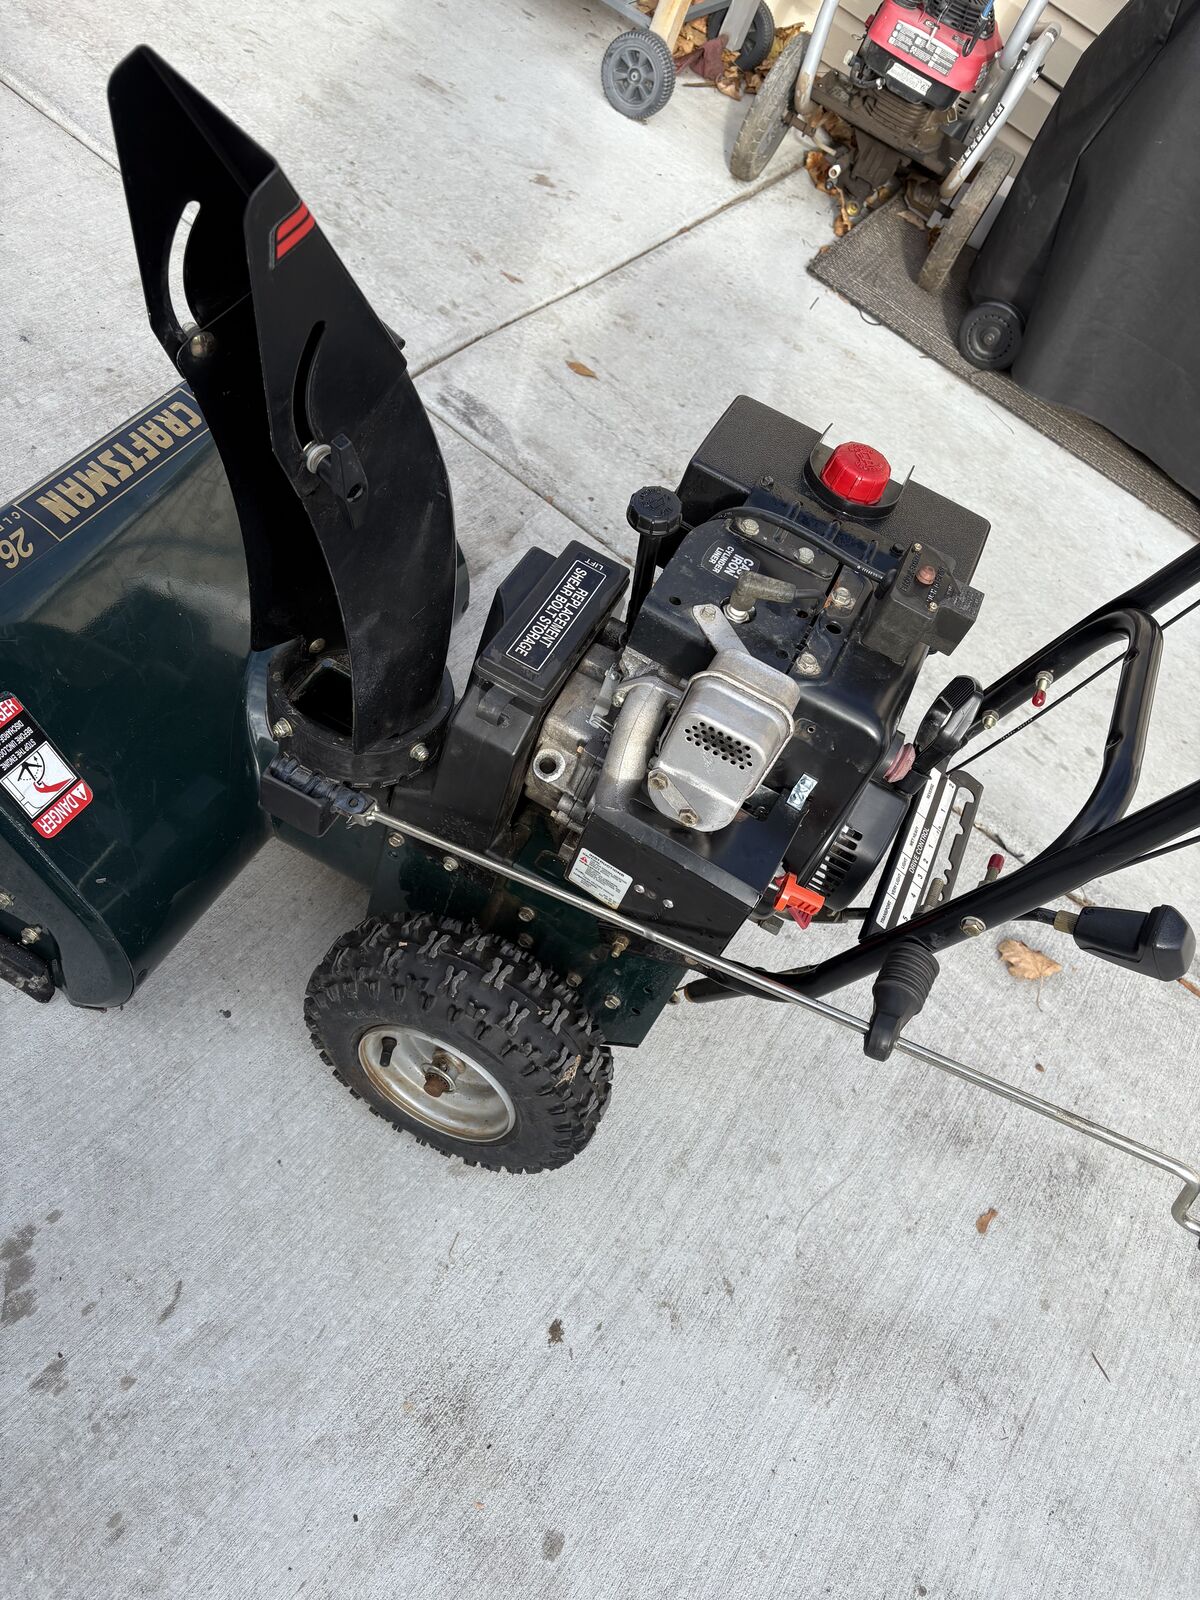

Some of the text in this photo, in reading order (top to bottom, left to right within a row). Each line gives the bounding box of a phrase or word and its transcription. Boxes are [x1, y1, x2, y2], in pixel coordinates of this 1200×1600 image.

[36, 401, 202, 524] CRAFTSMAN
[0, 527, 34, 569] 26
[709, 546, 725, 565] LINER
[712, 546, 735, 574] CYLINDER
[585, 559, 604, 571] LIFT
[724, 554, 744, 577] IRON
[515, 567, 587, 657] SHEAR BOLT STORAGE
[539, 587, 589, 649] REPLACEMENT
[14, 726, 34, 744] BEFORE
[0, 738, 37, 771] STOP THE ENGINE
[37, 793, 80, 834] DANGER
[908, 827, 930, 874] DRIVE CONTROL
[880, 900, 892, 924] TRANSPORT
